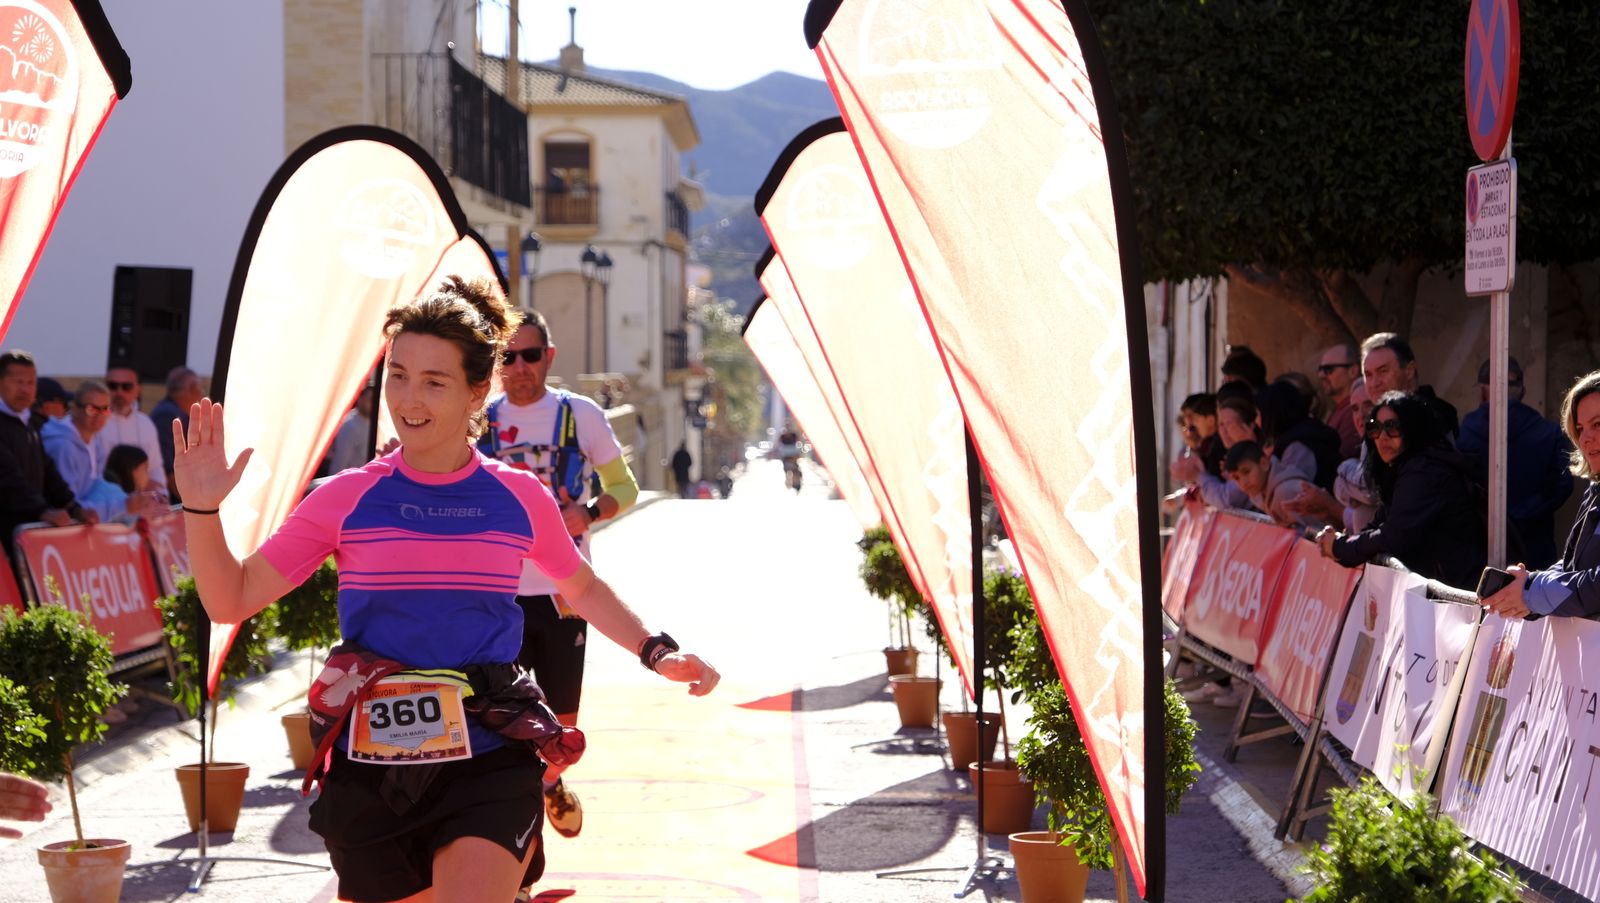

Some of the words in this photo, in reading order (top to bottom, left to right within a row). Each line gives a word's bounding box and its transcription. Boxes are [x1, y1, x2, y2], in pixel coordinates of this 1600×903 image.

[1480, 168, 1509, 189] PROHIBIDO
[1481, 202, 1507, 219] ESTACIONAR
[1466, 229, 1472, 243] EN
[1473, 226, 1485, 241] TODA
[1486, 226, 1492, 239] LA
[1493, 223, 1508, 238] PLAZA
[428, 507, 487, 518] LURBEL
[71, 562, 146, 619] VEOLIA
[370, 696, 441, 729] 360
